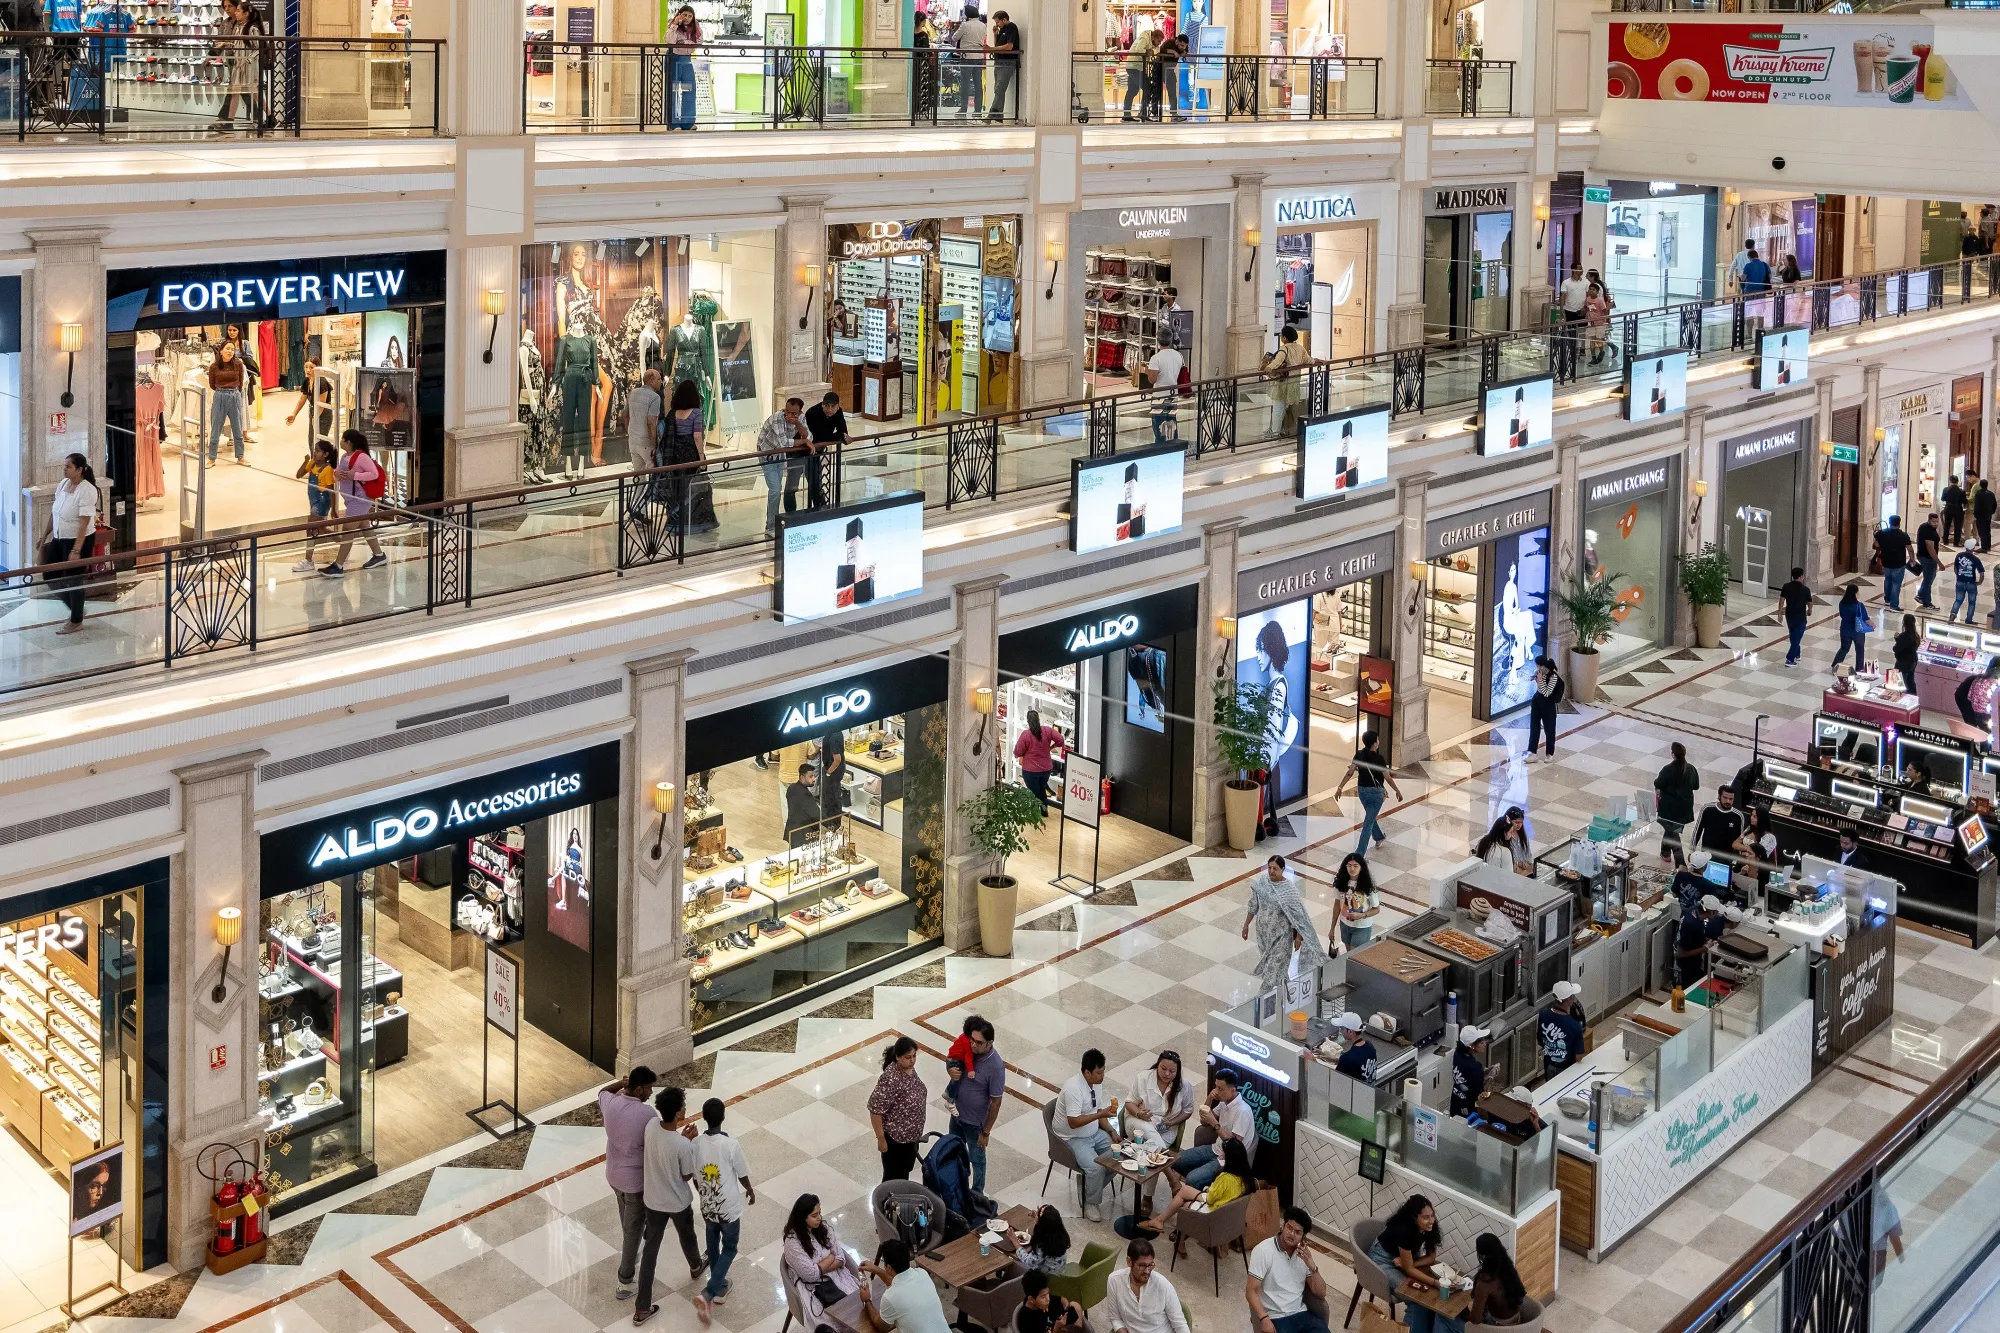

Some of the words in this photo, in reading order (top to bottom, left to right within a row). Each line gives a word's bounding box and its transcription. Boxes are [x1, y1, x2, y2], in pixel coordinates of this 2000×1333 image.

[1732, 54, 1780, 74] Krispy
[1779, 55, 1827, 73] Kreme
[1712, 90, 1736, 98] NOW
[1738, 91, 1765, 99] OPEN
[1782, 92, 1796, 100] 2ND
[1799, 93, 1831, 101] FLOOR
[1278, 198, 1356, 221] NAUTICA
[1435, 188, 1507, 209] MADISON
[1119, 209, 1157, 227] CALVIN
[1159, 207, 1187, 224] KLEIN
[1135, 229, 1171, 239] UNDERWEAR
[843, 240, 881, 256] Dayal
[882, 238, 928, 254] Opticals
[161, 275, 321, 312] FOREVER
[333, 269, 405, 300] NEW
[1901, 393, 1928, 411] KAMA
[1735, 440, 1761, 459] ARMANI
[1762, 431, 1796, 451] EXCHANGE
[1591, 478, 1623, 501] ARMANI
[1624, 468, 1665, 492] EXCHANGE
[1441, 522, 1489, 548] CHARLES
[1493, 517, 1501, 532] &
[1507, 508, 1536, 528] KEITH
[1259, 570, 1318, 599] CHARLES
[1325, 566, 1334, 581] &
[1341, 553, 1377, 576] KEITH
[1065, 614, 1139, 652] ALDO
[778, 688, 871, 733] ALDO
[1904, 729, 1960, 746] ANASTASIA
[308, 806, 438, 868] ALDO
[444, 773, 581, 828] Accessories
[1503, 900, 1525, 913] Anything
[495, 963, 510, 982] SALE
[493, 990, 511, 1013] 40%
[1842, 967, 1880, 1017] coffee!
[1541, 1022, 1567, 1042] Life
[1237, 1081, 1272, 1108] Love
